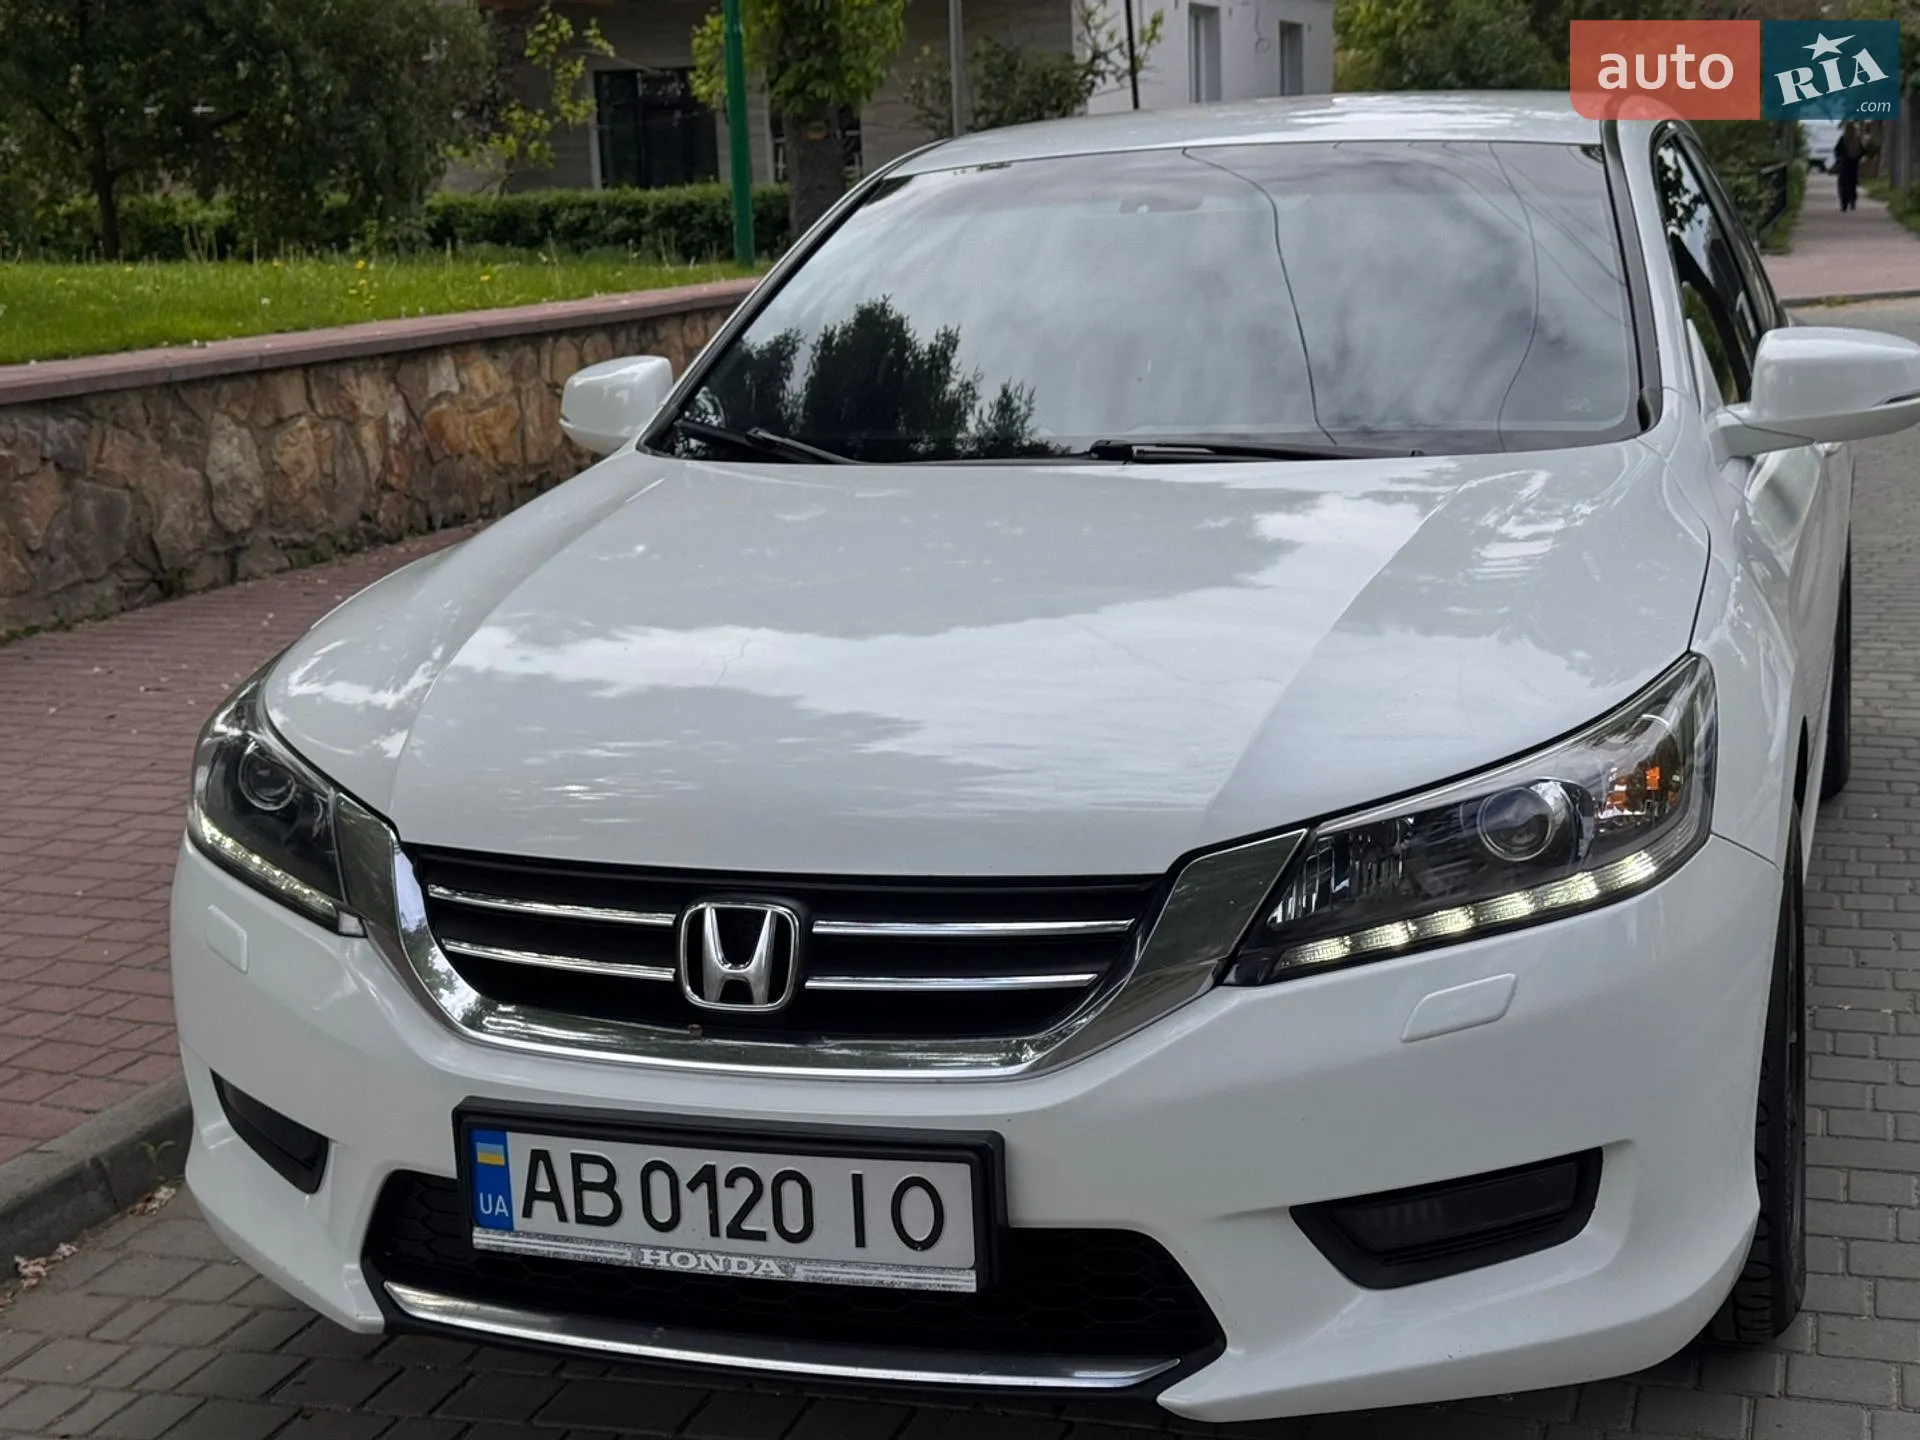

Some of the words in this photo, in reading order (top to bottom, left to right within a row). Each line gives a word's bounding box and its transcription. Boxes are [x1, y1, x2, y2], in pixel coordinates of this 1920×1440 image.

[480, 1193, 509, 1218] UA
[522, 1149, 622, 1227] AB
[640, 1160, 813, 1244] 0120
[640, 1249, 786, 1277] HONDA
